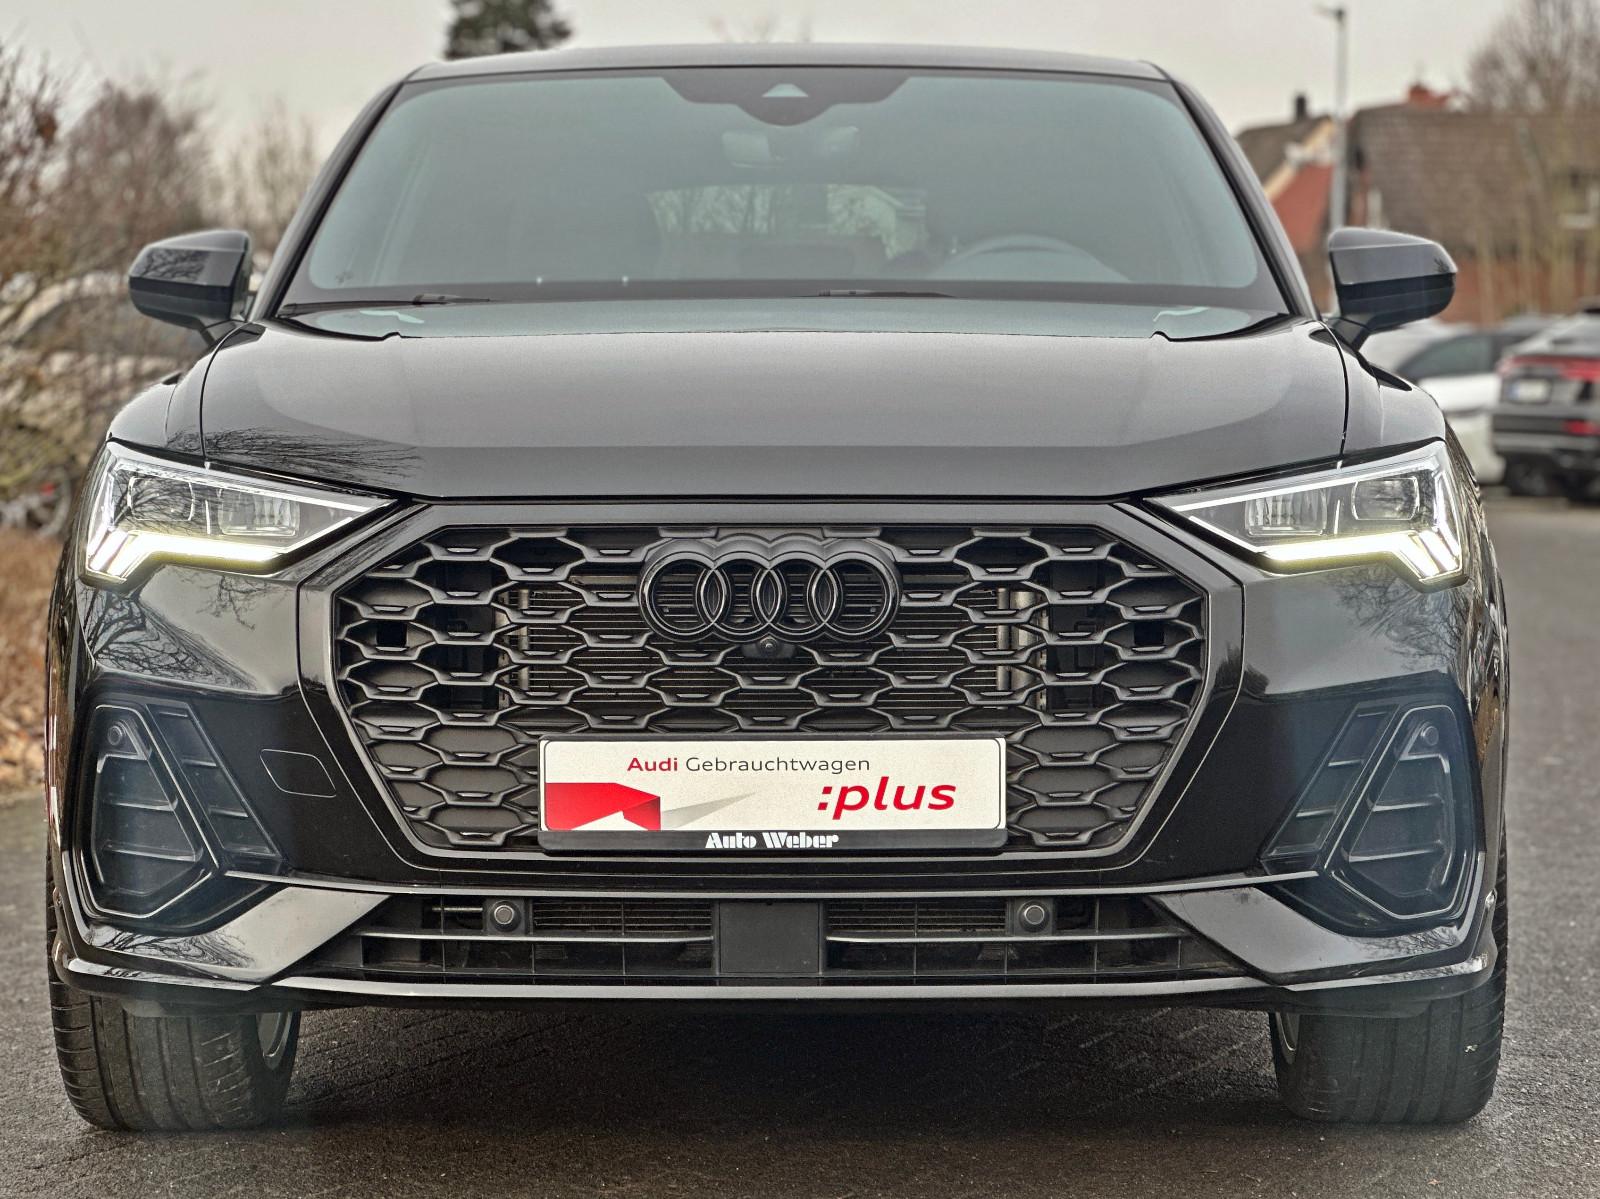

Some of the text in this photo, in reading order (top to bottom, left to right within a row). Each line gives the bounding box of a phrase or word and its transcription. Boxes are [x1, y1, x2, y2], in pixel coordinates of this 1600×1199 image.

[627, 756, 870, 775] Audi Gebrauchtwagen
[705, 832, 839, 849] Auto Weber
